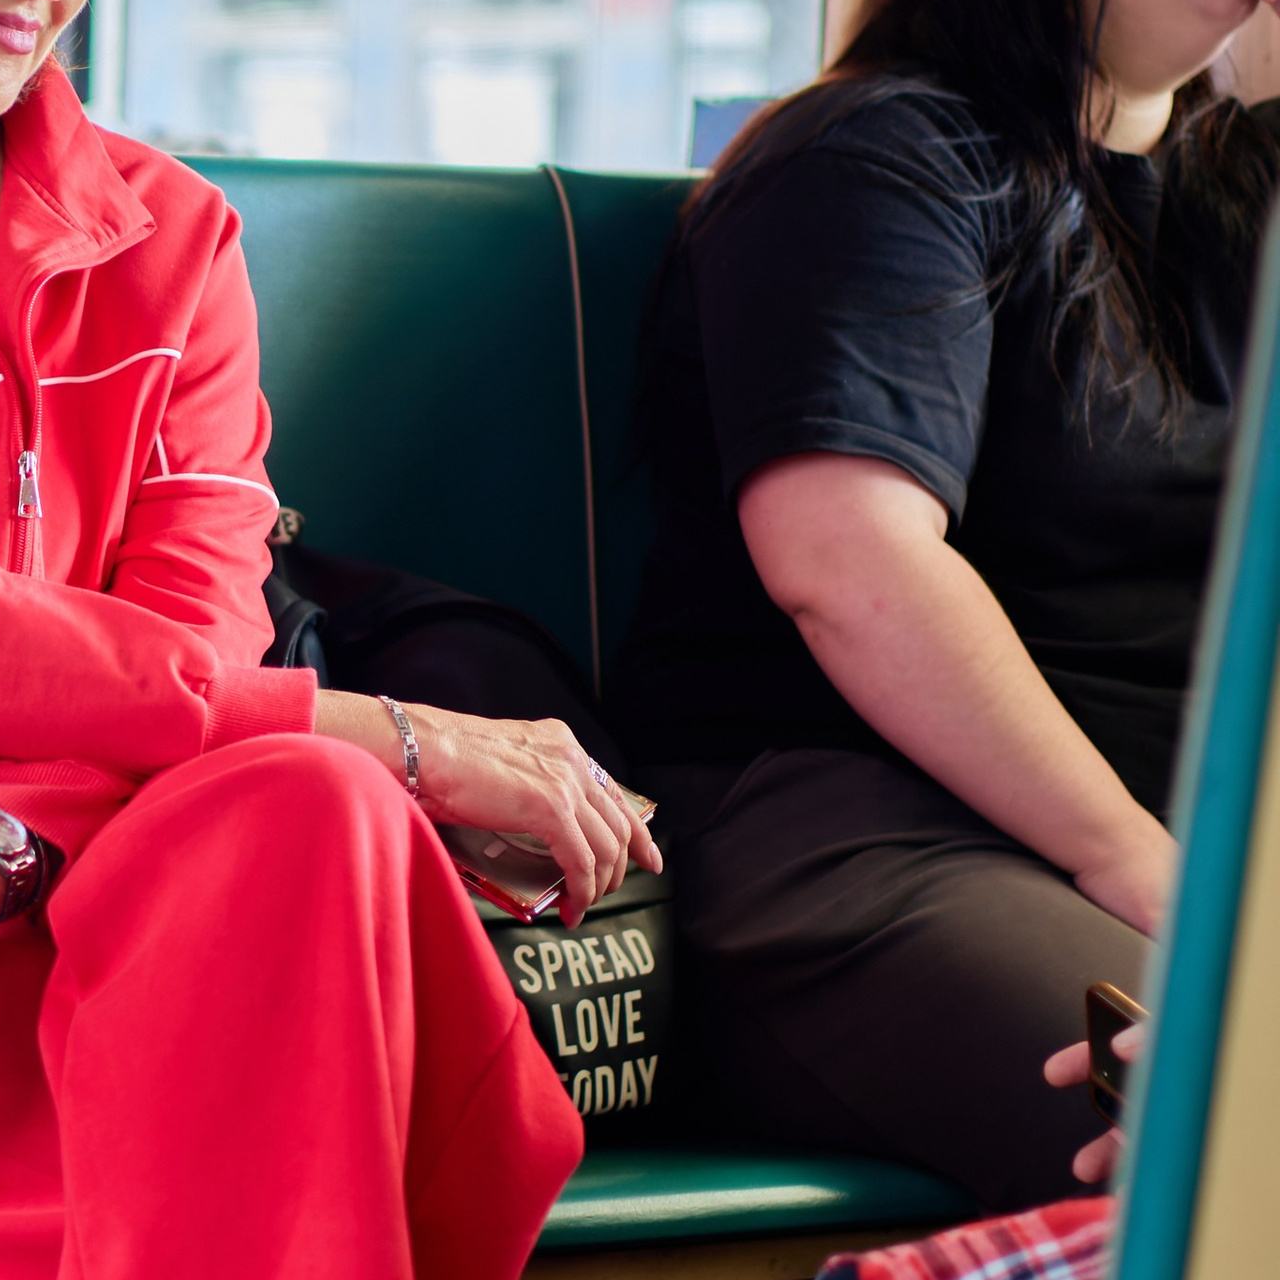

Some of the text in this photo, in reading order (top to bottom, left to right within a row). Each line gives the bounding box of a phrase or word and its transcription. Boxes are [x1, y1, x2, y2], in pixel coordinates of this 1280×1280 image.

[513, 928, 655, 994] SPREAD
[551, 989, 645, 1057] LOVE
[558, 1054, 659, 1116] ODAY
